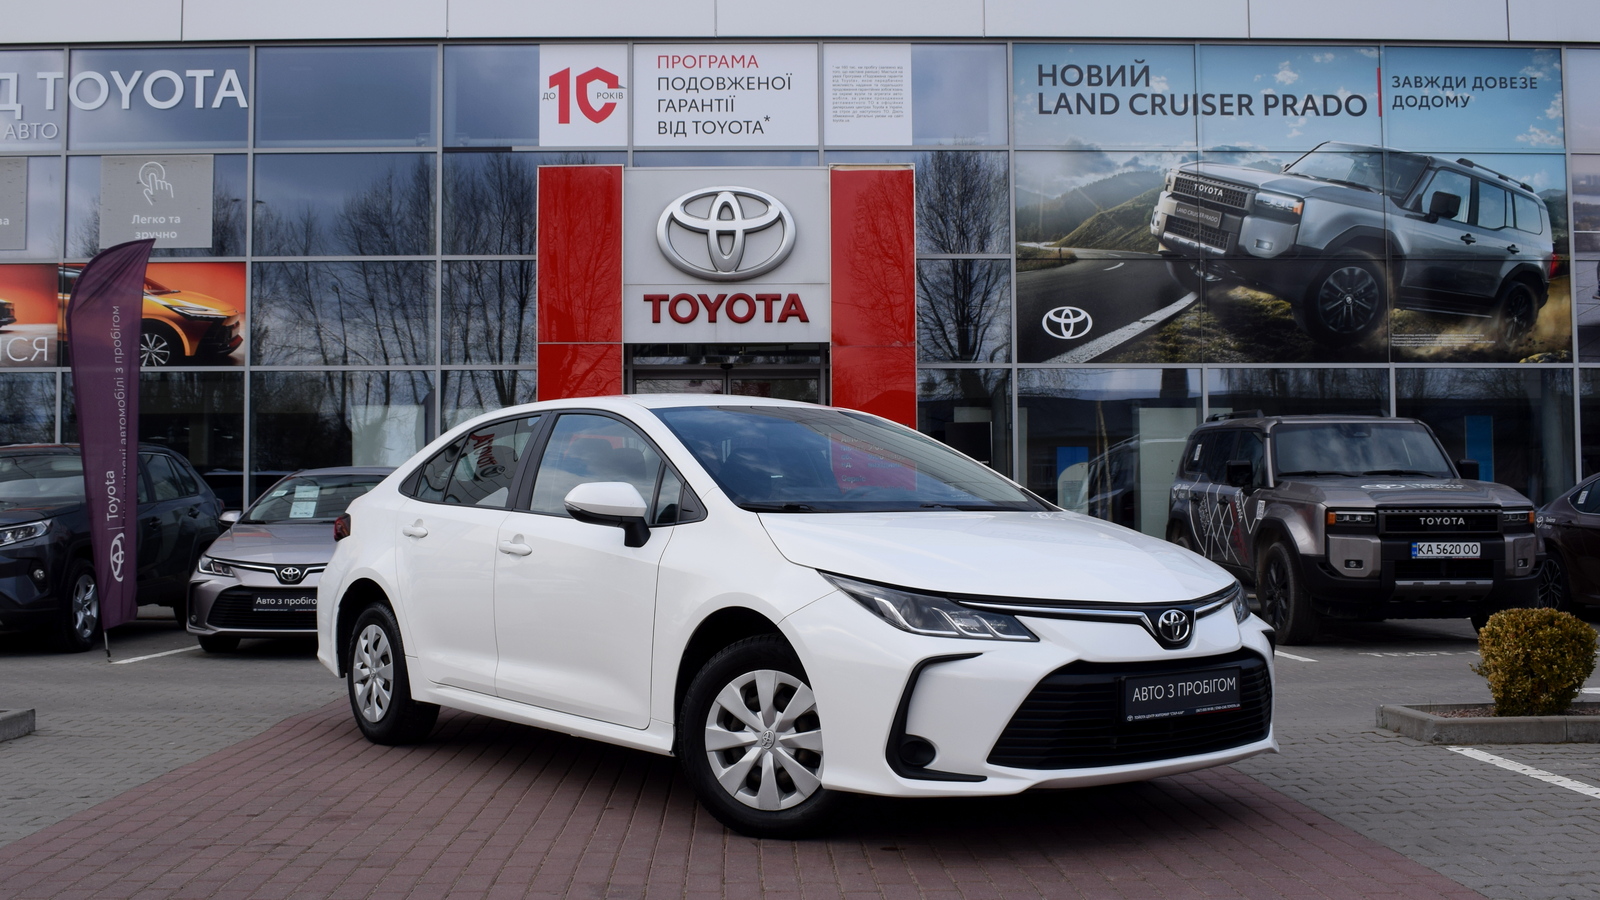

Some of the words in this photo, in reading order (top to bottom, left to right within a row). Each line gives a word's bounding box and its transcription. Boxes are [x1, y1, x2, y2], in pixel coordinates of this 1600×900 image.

[657, 54, 759, 69] ПРОГРАМА
[1037, 59, 1150, 88] НОВИЙ
[37, 69, 249, 111] TOYOTA
[657, 73, 793, 93] ПОДОВЖЕНОЇ
[1392, 75, 1467, 92] ЗАВЖДИ
[1471, 75, 1538, 92] ДОВЕЗЕ
[542, 92, 556, 101] ДО
[596, 92, 624, 100] РОКІВ
[657, 95, 736, 113] ГАРАНТІЇ
[1392, 94, 1471, 111] ДОДОМУ
[1038, 93, 1121, 116] LAND
[1128, 93, 1255, 117] CRUISER
[1264, 94, 1368, 118] PRADO
[4, 122, 59, 140] АВТО
[657, 121, 687, 137] ВІД
[1194, 183, 1223, 197] TOYOTA
[131, 214, 166, 225] Легко
[168, 216, 181, 224] та
[135, 230, 178, 240] зручно
[643, 292, 810, 324] TOYOTA
[110, 305, 125, 365] пробігом
[0, 336, 48, 362] СЯ
[115, 366, 124, 374] з
[105, 470, 121, 521] Toyota
[1419, 517, 1465, 525] TOYOTA
[1418, 544, 1433, 554] KA
[1436, 543, 1461, 555] 5620
[255, 597, 276, 605] Авто
[1132, 684, 1165, 702] АВТО
[1177, 676, 1236, 696] ПРОБІГОМ
